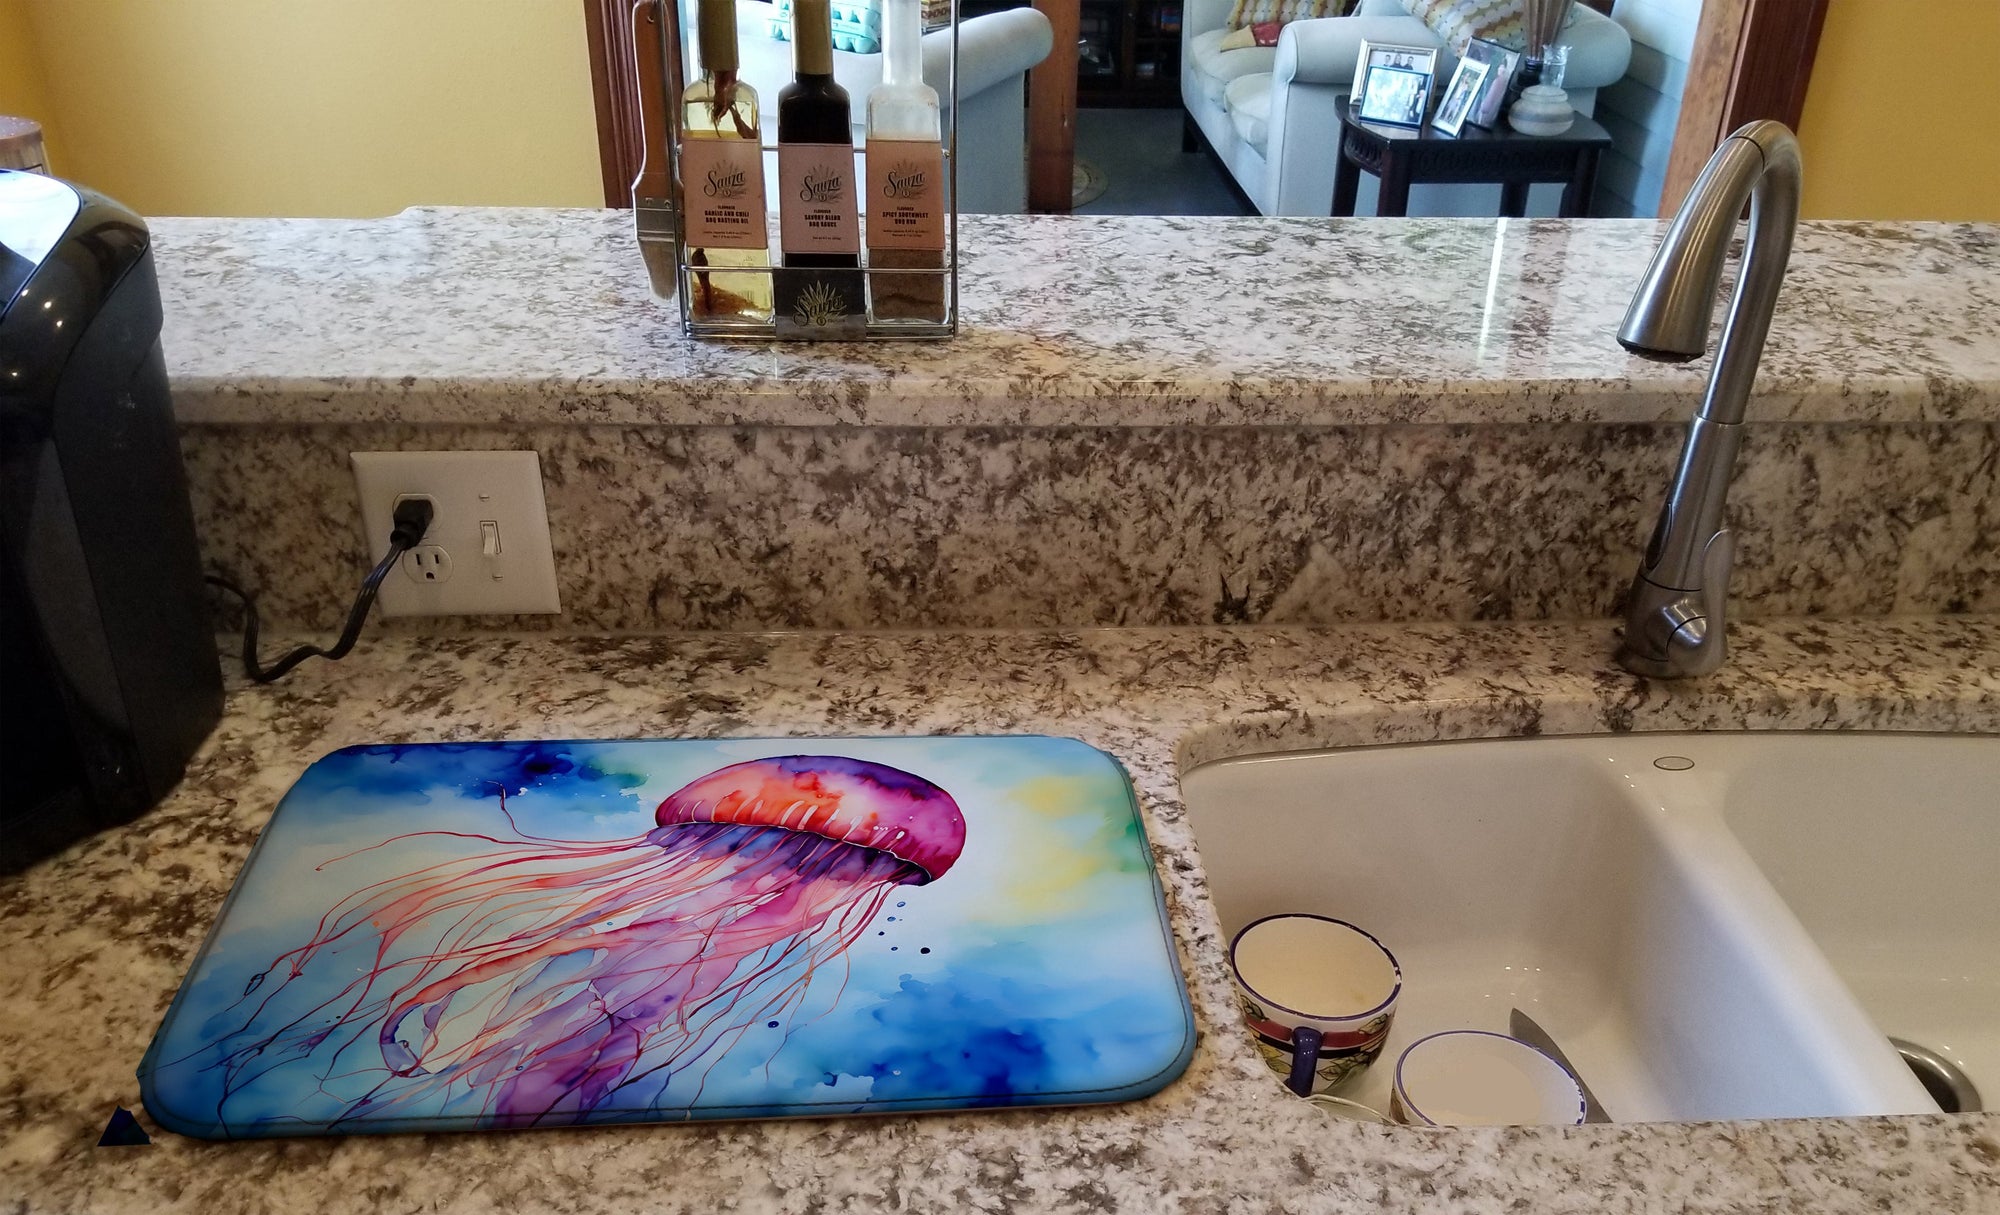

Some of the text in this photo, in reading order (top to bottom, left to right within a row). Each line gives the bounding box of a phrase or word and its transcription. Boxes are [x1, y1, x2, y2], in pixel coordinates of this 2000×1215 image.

[704, 170, 746, 197] Sauza
[800, 175, 842, 202] Sauza
[884, 172, 927, 198] Sauza
